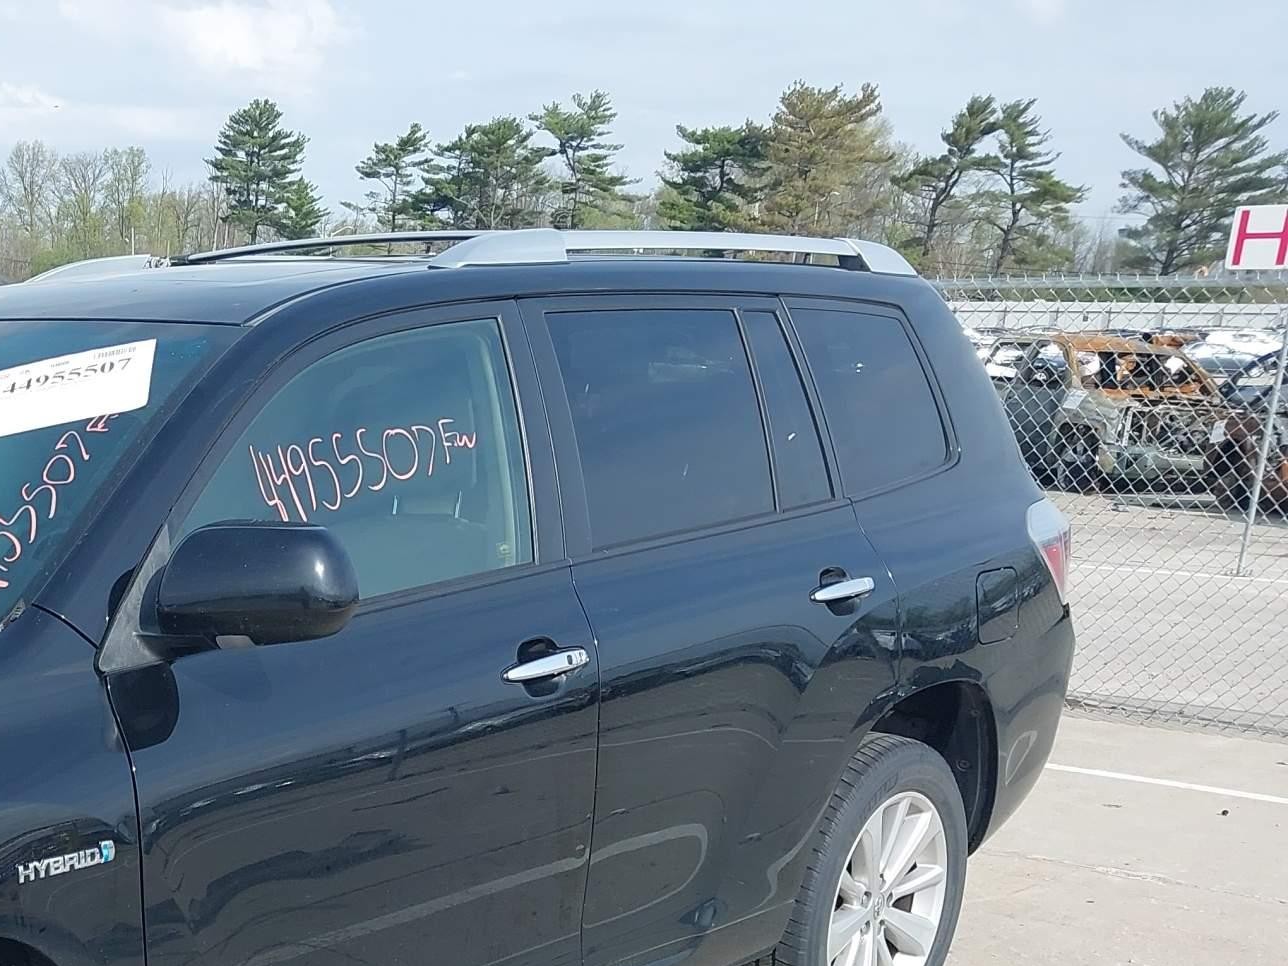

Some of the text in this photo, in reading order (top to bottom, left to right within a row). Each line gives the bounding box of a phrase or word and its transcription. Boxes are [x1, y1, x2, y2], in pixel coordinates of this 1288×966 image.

[1231, 209, 1288, 266] H
[2, 357, 133, 394] 44955507
[249, 424, 436, 523] 44955507
[17, 847, 101, 884] HYBRID
